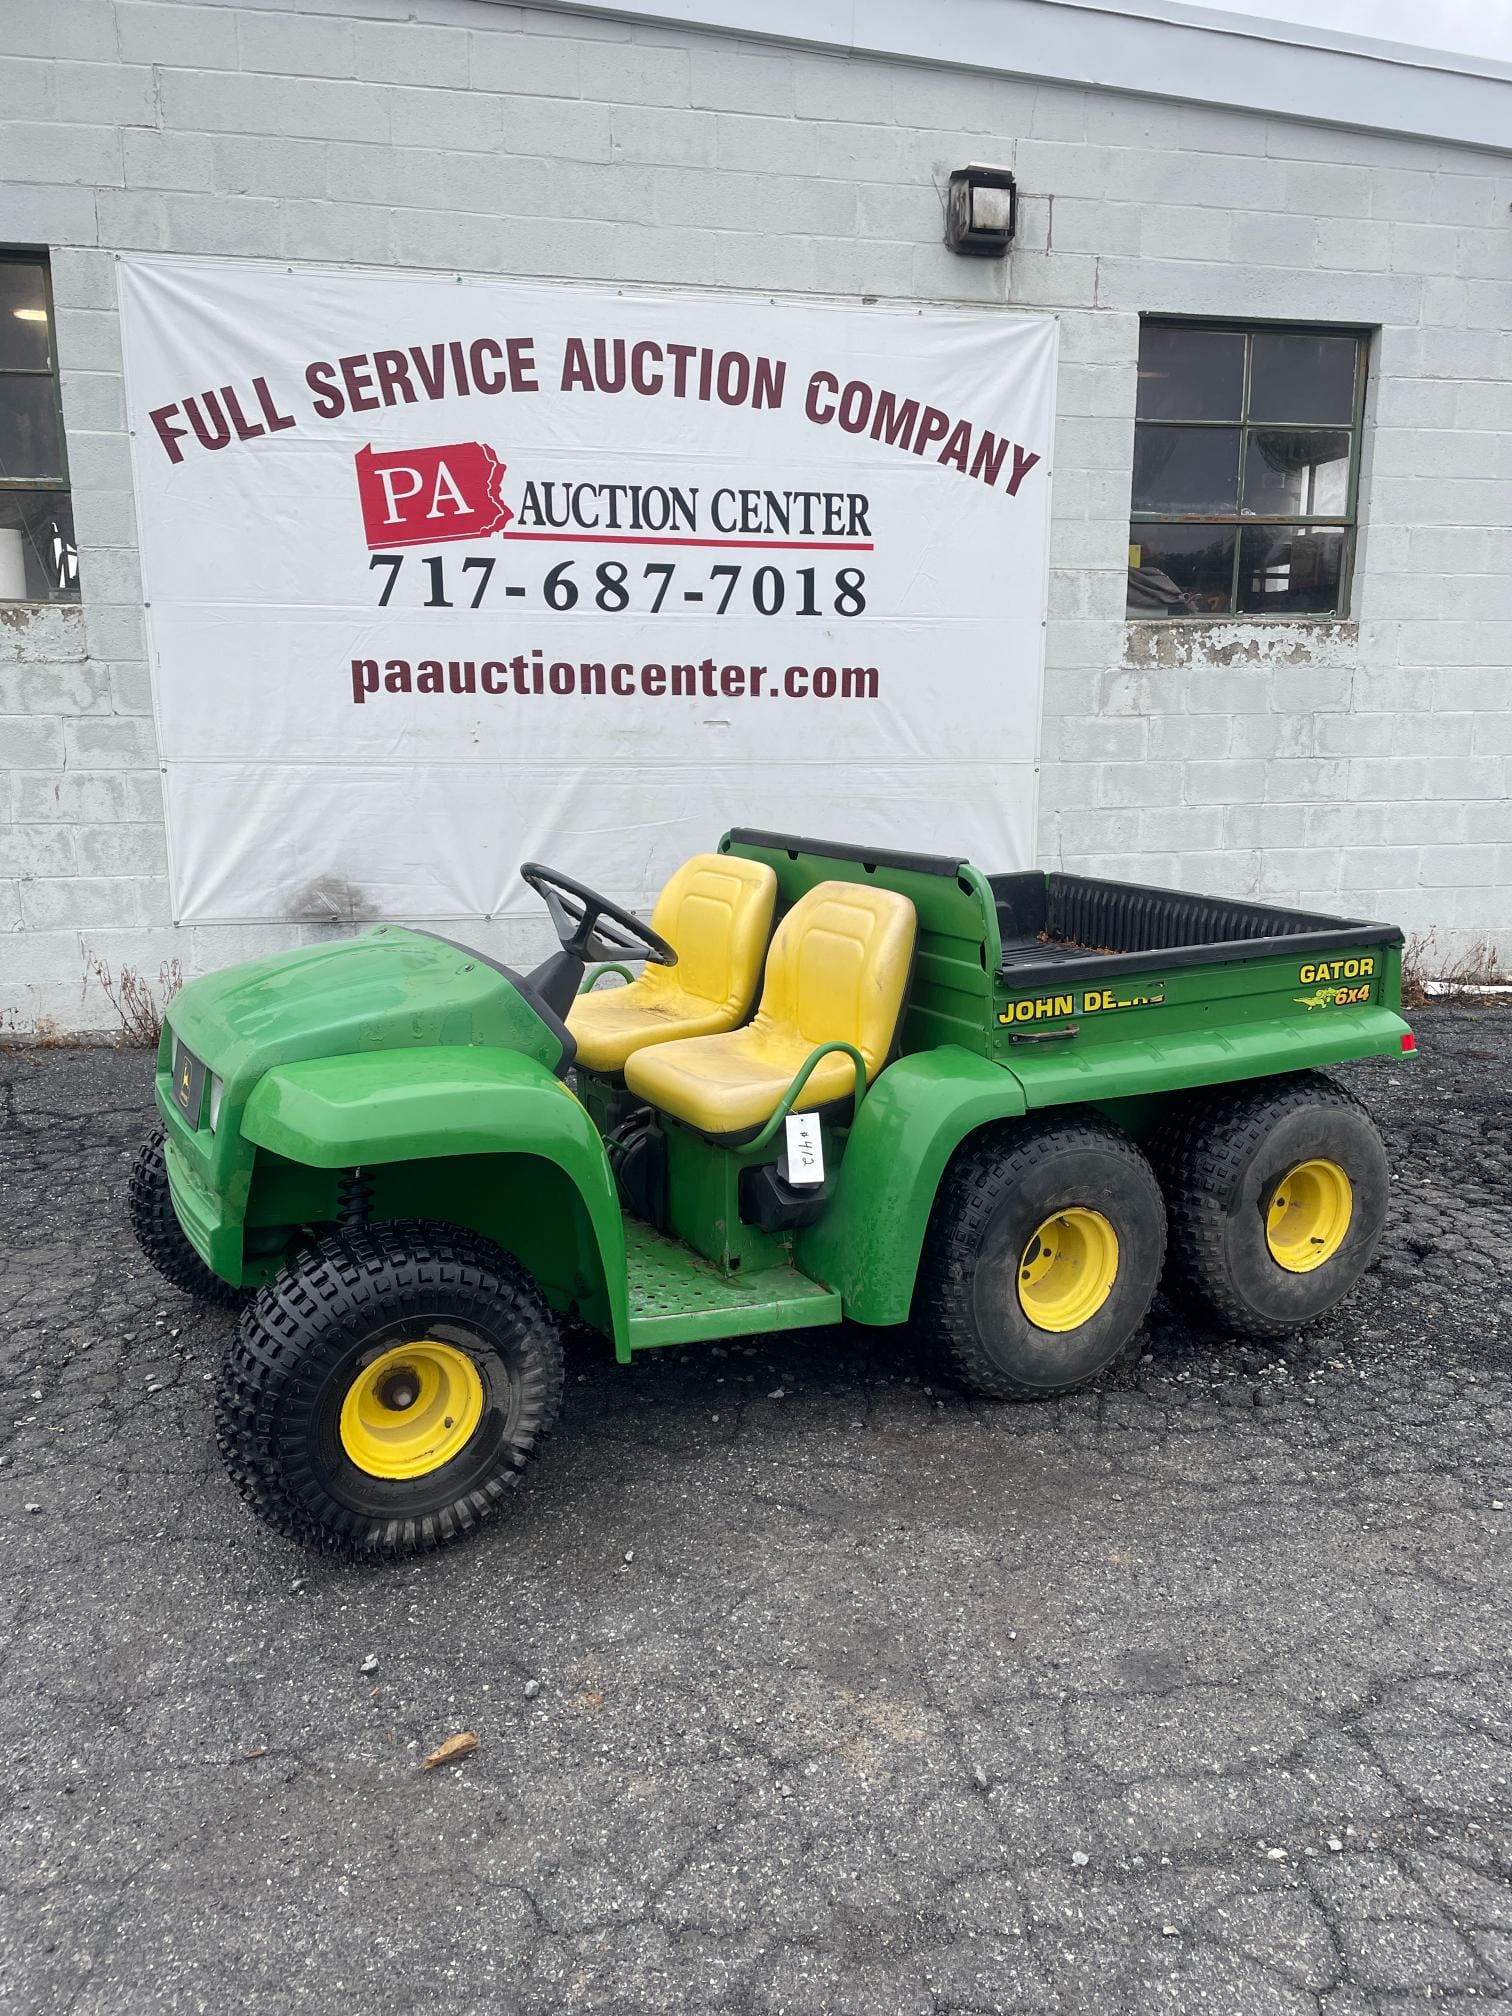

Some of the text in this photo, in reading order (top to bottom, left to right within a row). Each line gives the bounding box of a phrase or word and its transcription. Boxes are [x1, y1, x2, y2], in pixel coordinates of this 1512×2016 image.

[148, 337, 1041, 497] FULL SERVICE AUCTION COMPANY
[374, 462, 873, 538] PA AUCTION CENTER
[367, 554, 867, 617] 717-687-7018
[351, 649, 880, 704] paauctioncenter.com
[1299, 957, 1375, 984] GATOR
[998, 993, 1074, 1024] JOHN
[1334, 984, 1371, 1005] 6x4
[798, 1131, 815, 1167] #412
